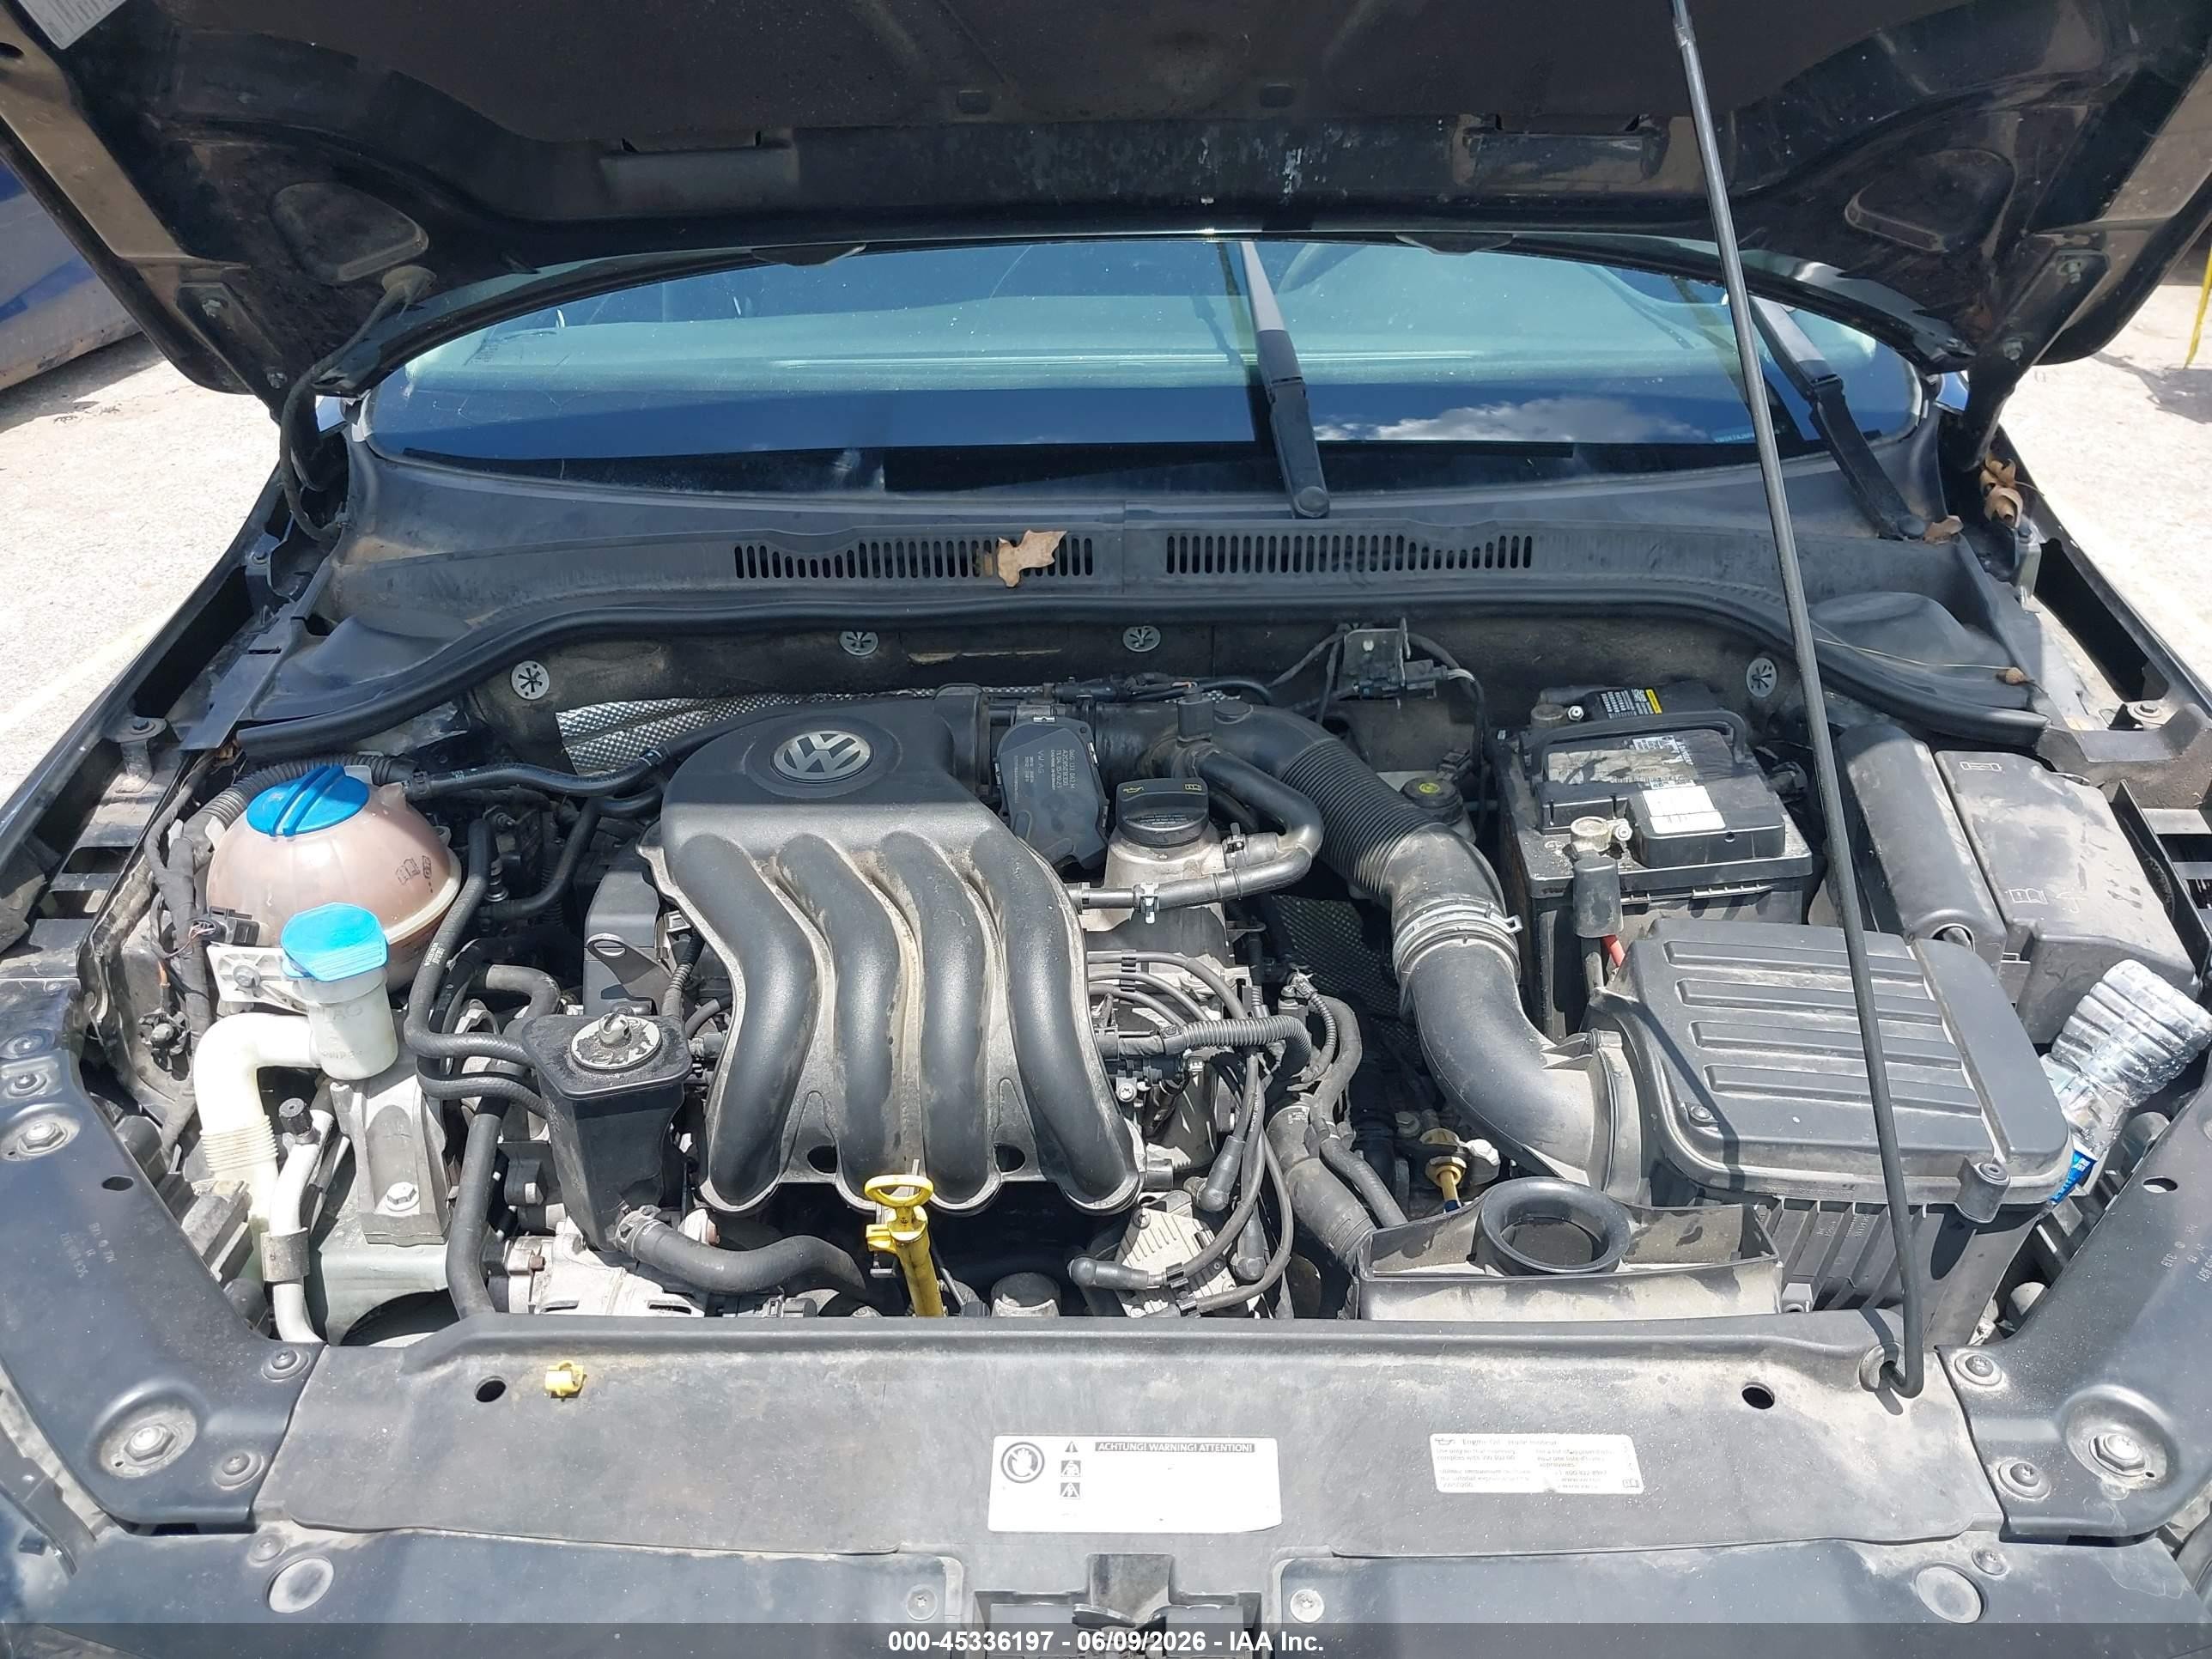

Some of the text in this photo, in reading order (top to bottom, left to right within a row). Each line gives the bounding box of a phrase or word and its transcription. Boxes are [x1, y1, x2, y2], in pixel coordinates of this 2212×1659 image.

[1098, 1442, 1253, 1452] ACHTUNG! WARNING! ATTENTION!
